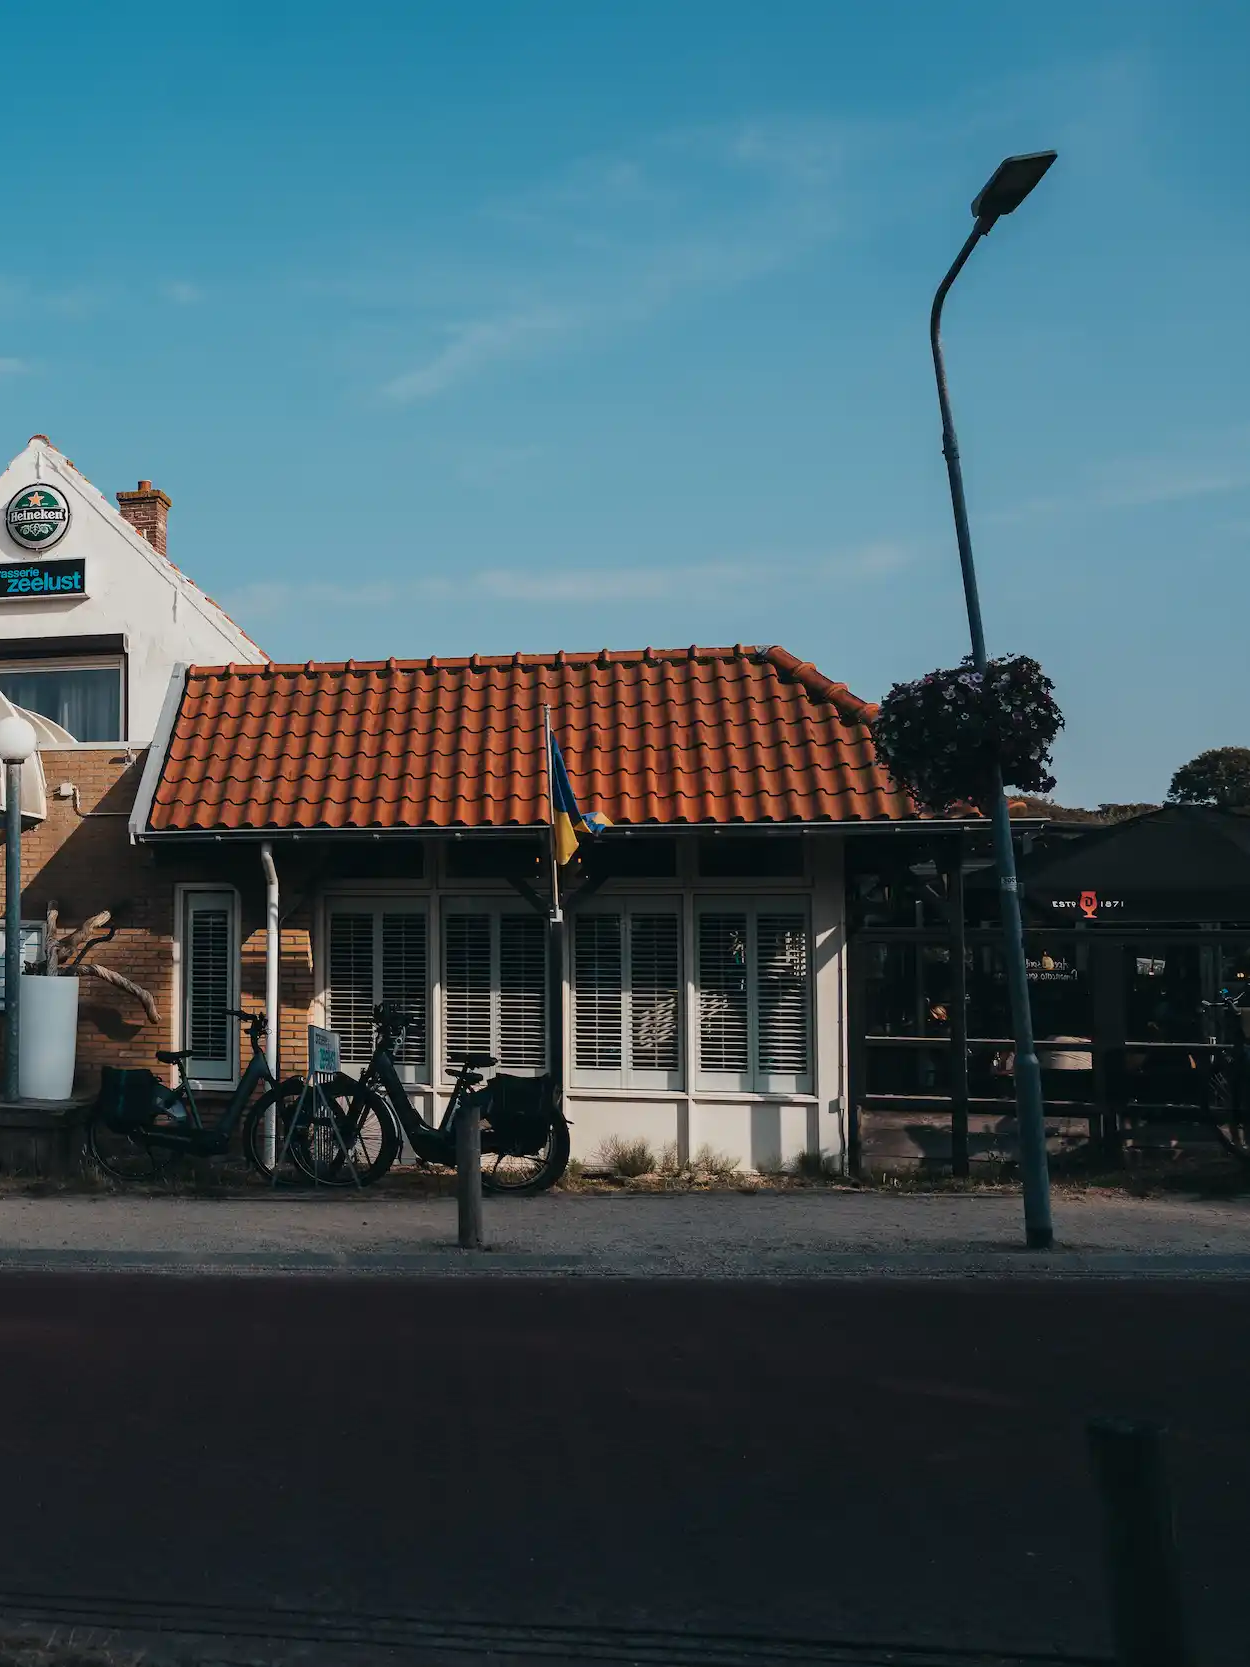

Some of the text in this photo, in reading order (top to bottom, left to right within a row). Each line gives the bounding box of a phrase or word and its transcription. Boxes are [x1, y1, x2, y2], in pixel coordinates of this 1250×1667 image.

[10, 509, 64, 522] Heineken
[7, 571, 82, 593] zeelust
[1100, 900, 1124, 908] 1871
